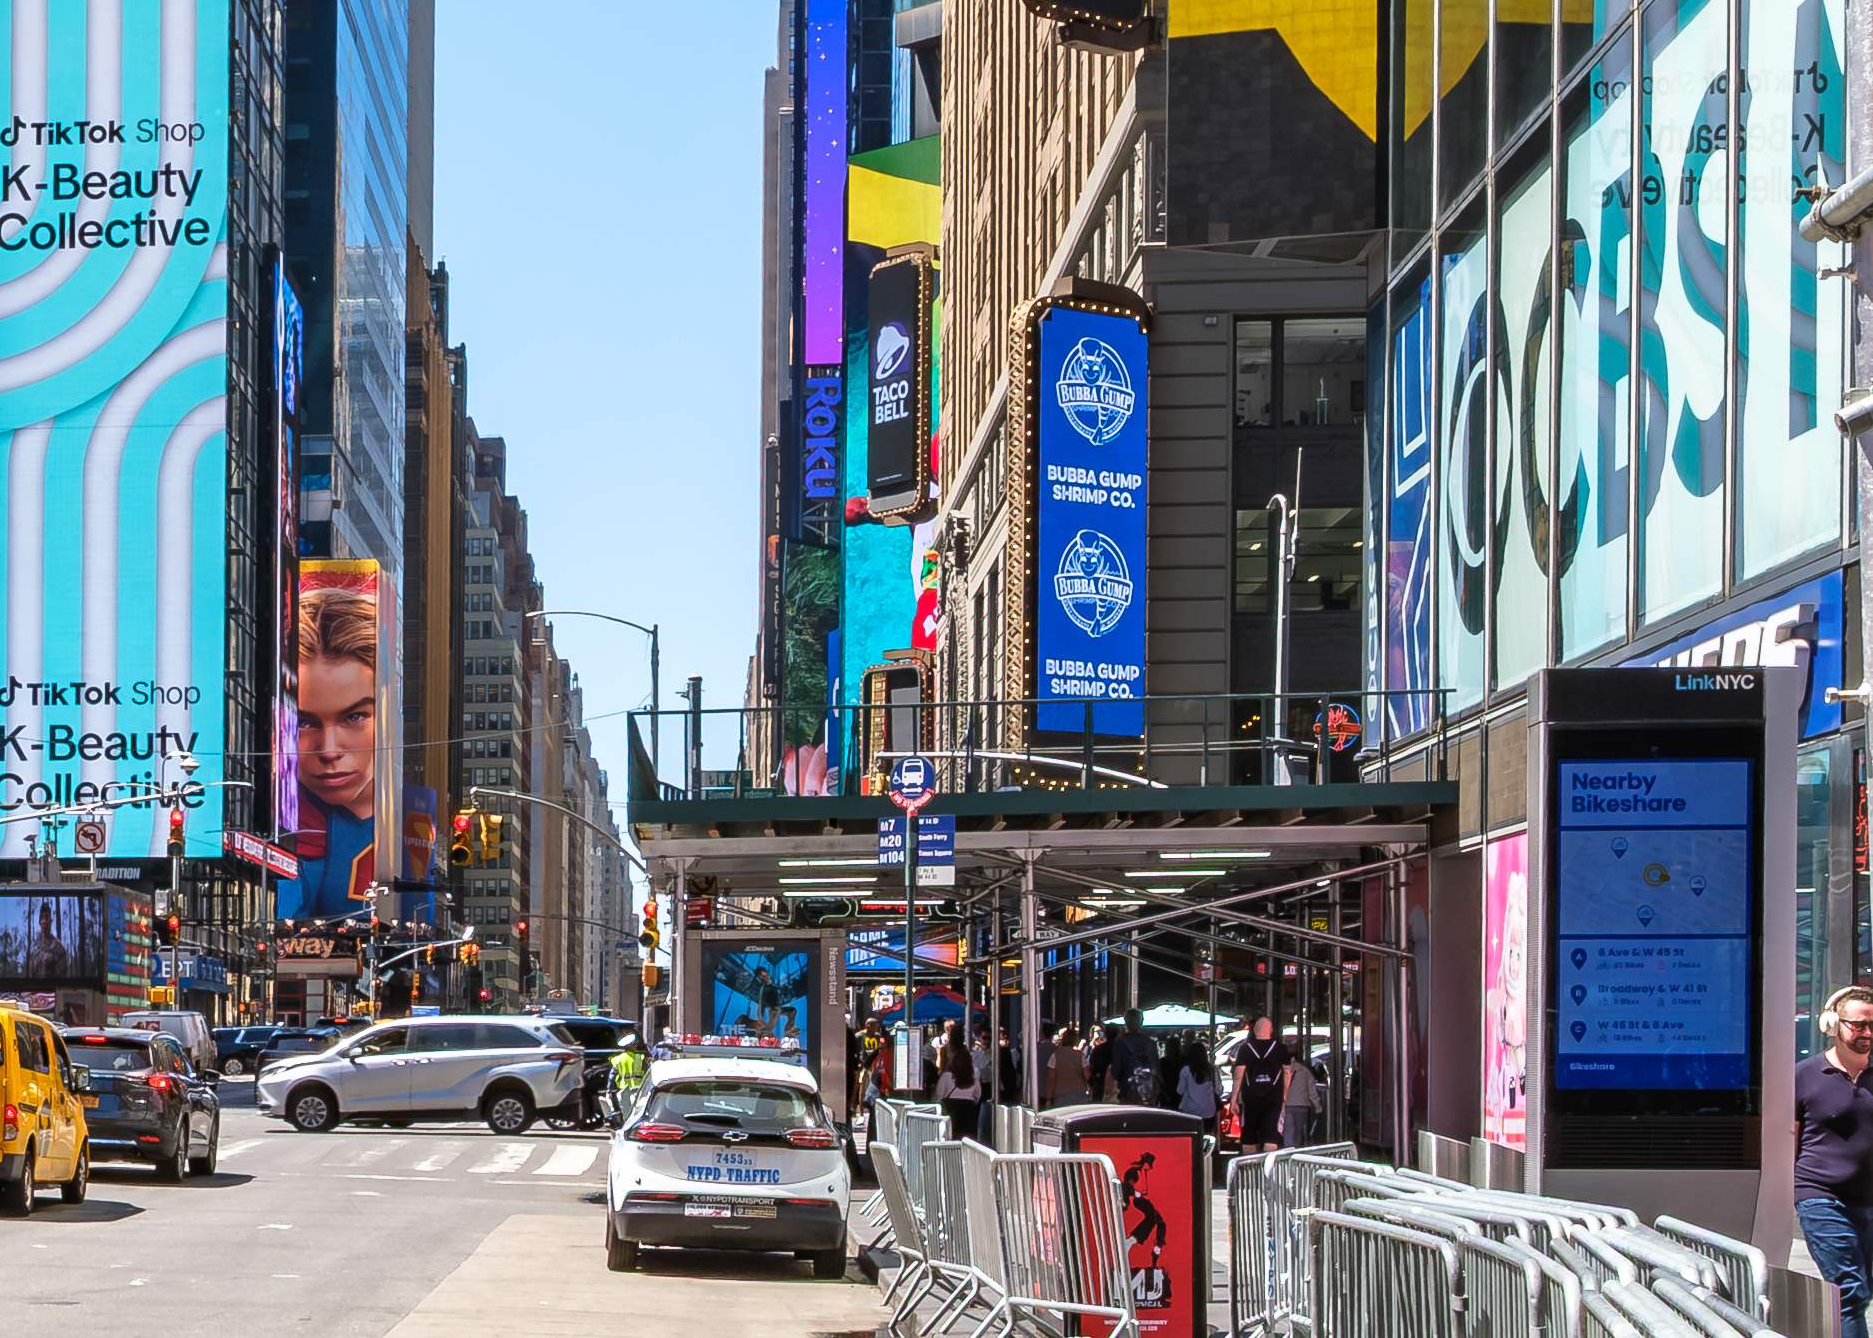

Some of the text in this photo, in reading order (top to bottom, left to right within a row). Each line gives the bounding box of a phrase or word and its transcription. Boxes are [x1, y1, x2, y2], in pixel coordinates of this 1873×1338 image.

[31, 118, 206, 146] TikTok Shop
[1, 162, 202, 206] K-Beauty
[872, 379, 909, 409] TACO
[1061, 385, 1133, 411] BUBBA GUMP
[875, 400, 909, 425] BELL
[805, 378, 843, 498] ROKU
[1047, 464, 1142, 490] BUBBA GUMP
[1052, 484, 1136, 509] SHRIMP CO.
[1059, 576, 1131, 600] BUBBA GUMP
[1045, 658, 1140, 682] BUBBA GUMP
[26, 679, 202, 709] TikTok Shop
[1050, 677, 1134, 700] SHRIMP CO.
[1675, 674, 1755, 691] LinkNYC
[1571, 772, 1657, 796] Nearby
[1571, 794, 1687, 814] Bikeshare
[880, 818, 896, 832] M7
[879, 834, 902, 848] M20
[879, 850, 905, 864] M104
[1608, 948, 1628, 957] Ave
[1630, 948, 1640, 957] &
[1641, 948, 1655, 957] W
[828, 947, 839, 1006] Newsstand
[1598, 984, 1656, 996] Broadway
[1657, 984, 1666, 993] &
[1668, 984, 1680, 993] W
[1696, 983, 1708, 993] St
[1598, 1020, 1609, 1029] W
[1662, 1020, 1684, 1029] Ave
[1569, 1063, 1616, 1071] Bikeshare
[715, 1152, 743, 1164] 7453
[687, 1165, 781, 1184] NYPD TRAFFIC
